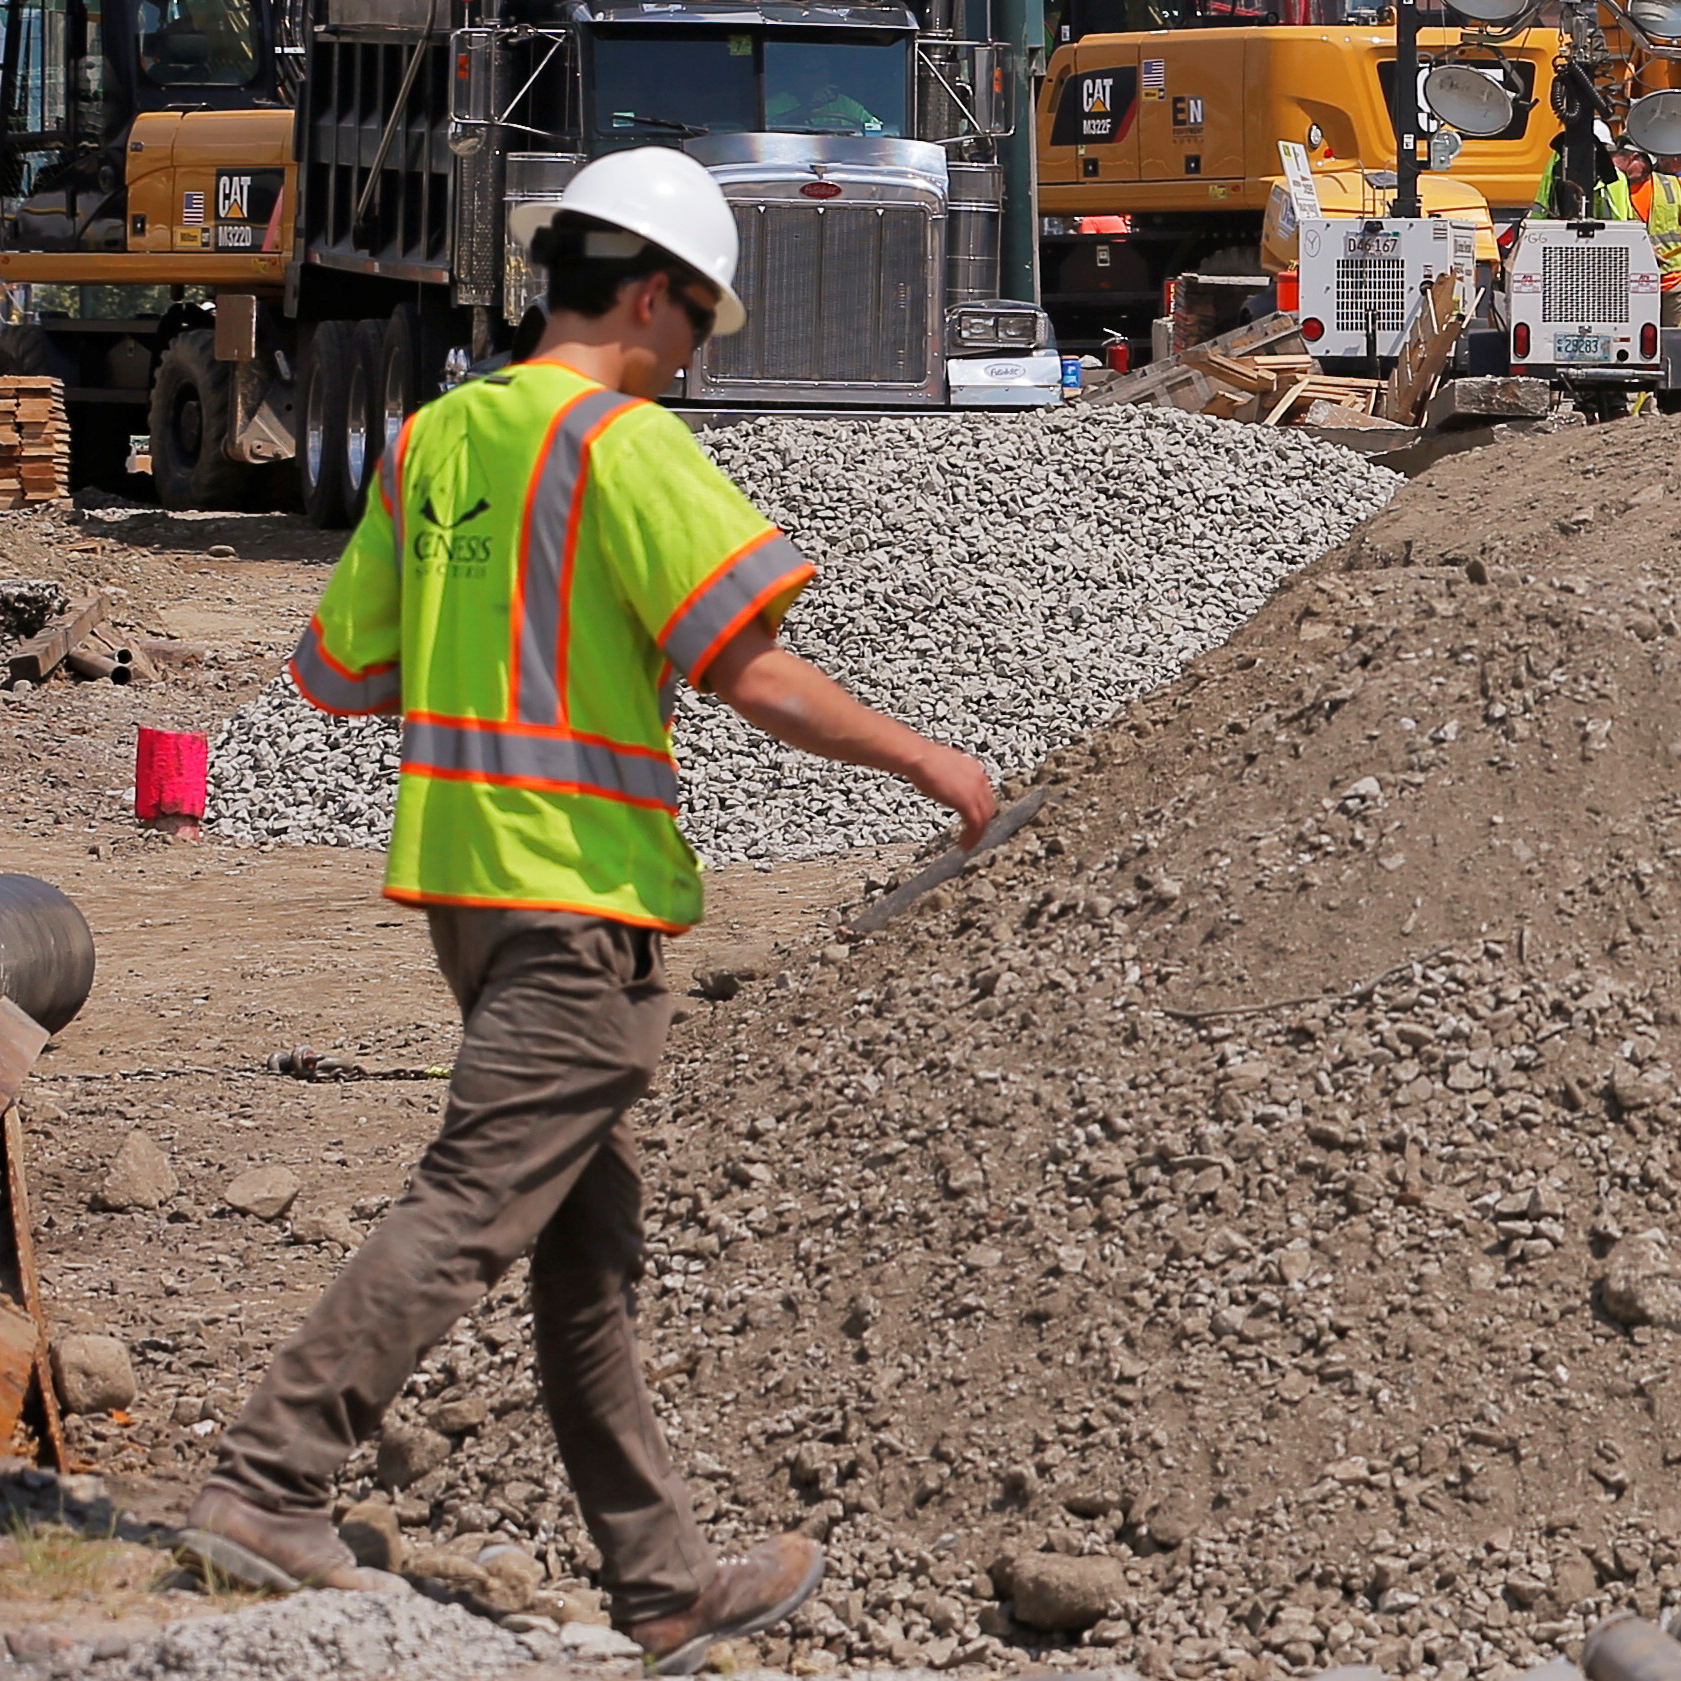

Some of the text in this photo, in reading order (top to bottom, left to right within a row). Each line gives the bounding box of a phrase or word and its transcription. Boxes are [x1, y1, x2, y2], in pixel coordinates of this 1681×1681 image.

[1083, 78, 1113, 113] CAT
[1083, 119, 1112, 135] M322F
[218, 175, 252, 218] CAT
[218, 225, 252, 247] M322D
